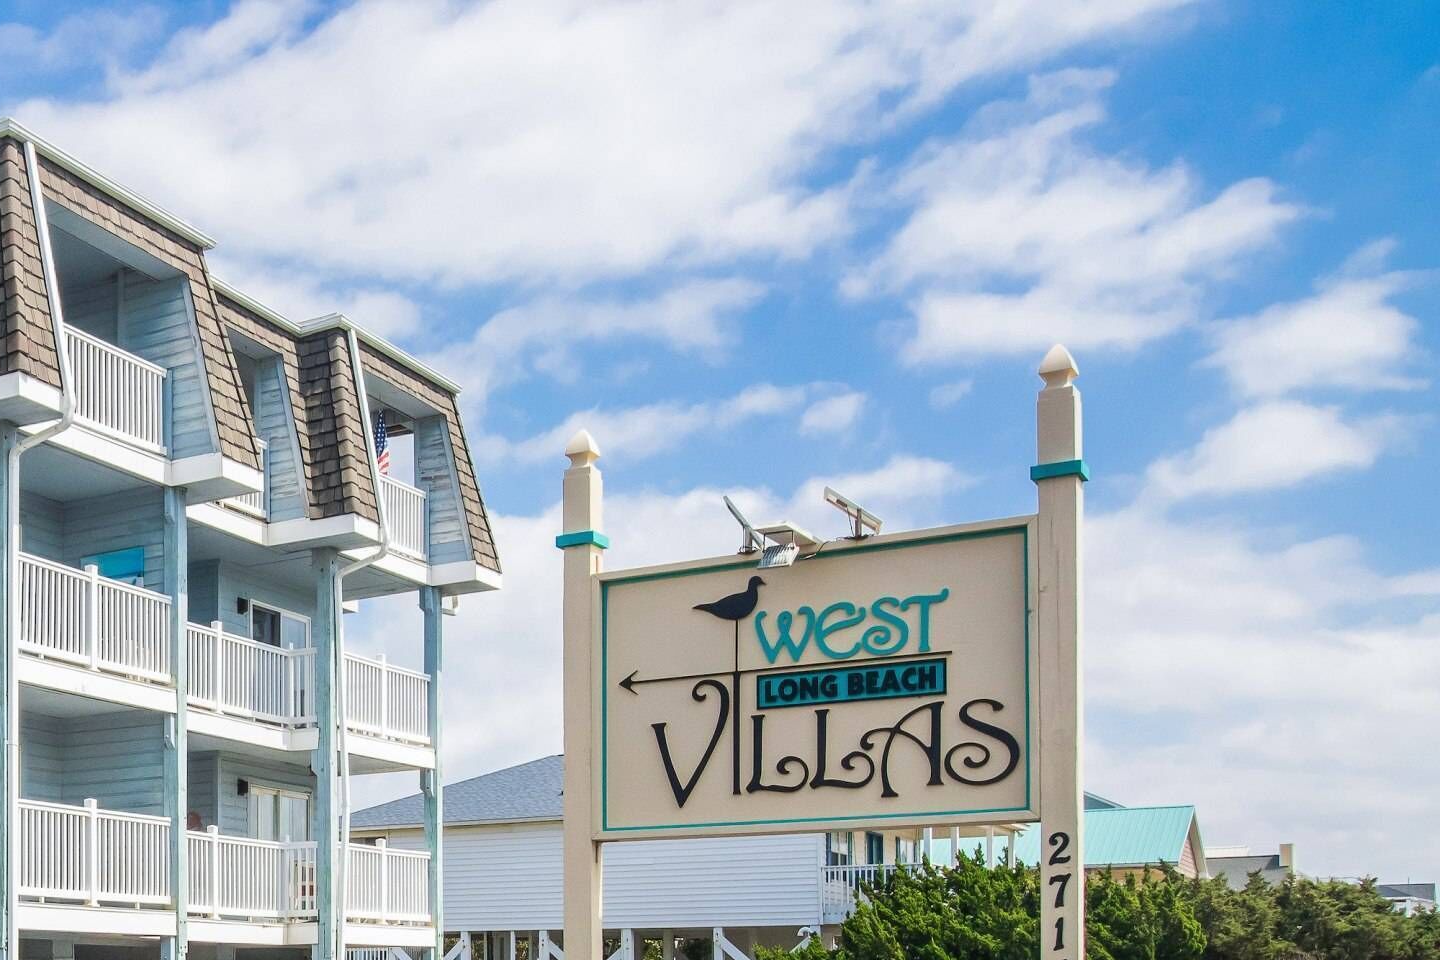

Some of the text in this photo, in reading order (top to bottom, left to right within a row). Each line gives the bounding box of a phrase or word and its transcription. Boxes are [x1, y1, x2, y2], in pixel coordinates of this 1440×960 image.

[764, 665, 937, 703] LONG BEACH
[651, 678, 1021, 809] VILLAS
